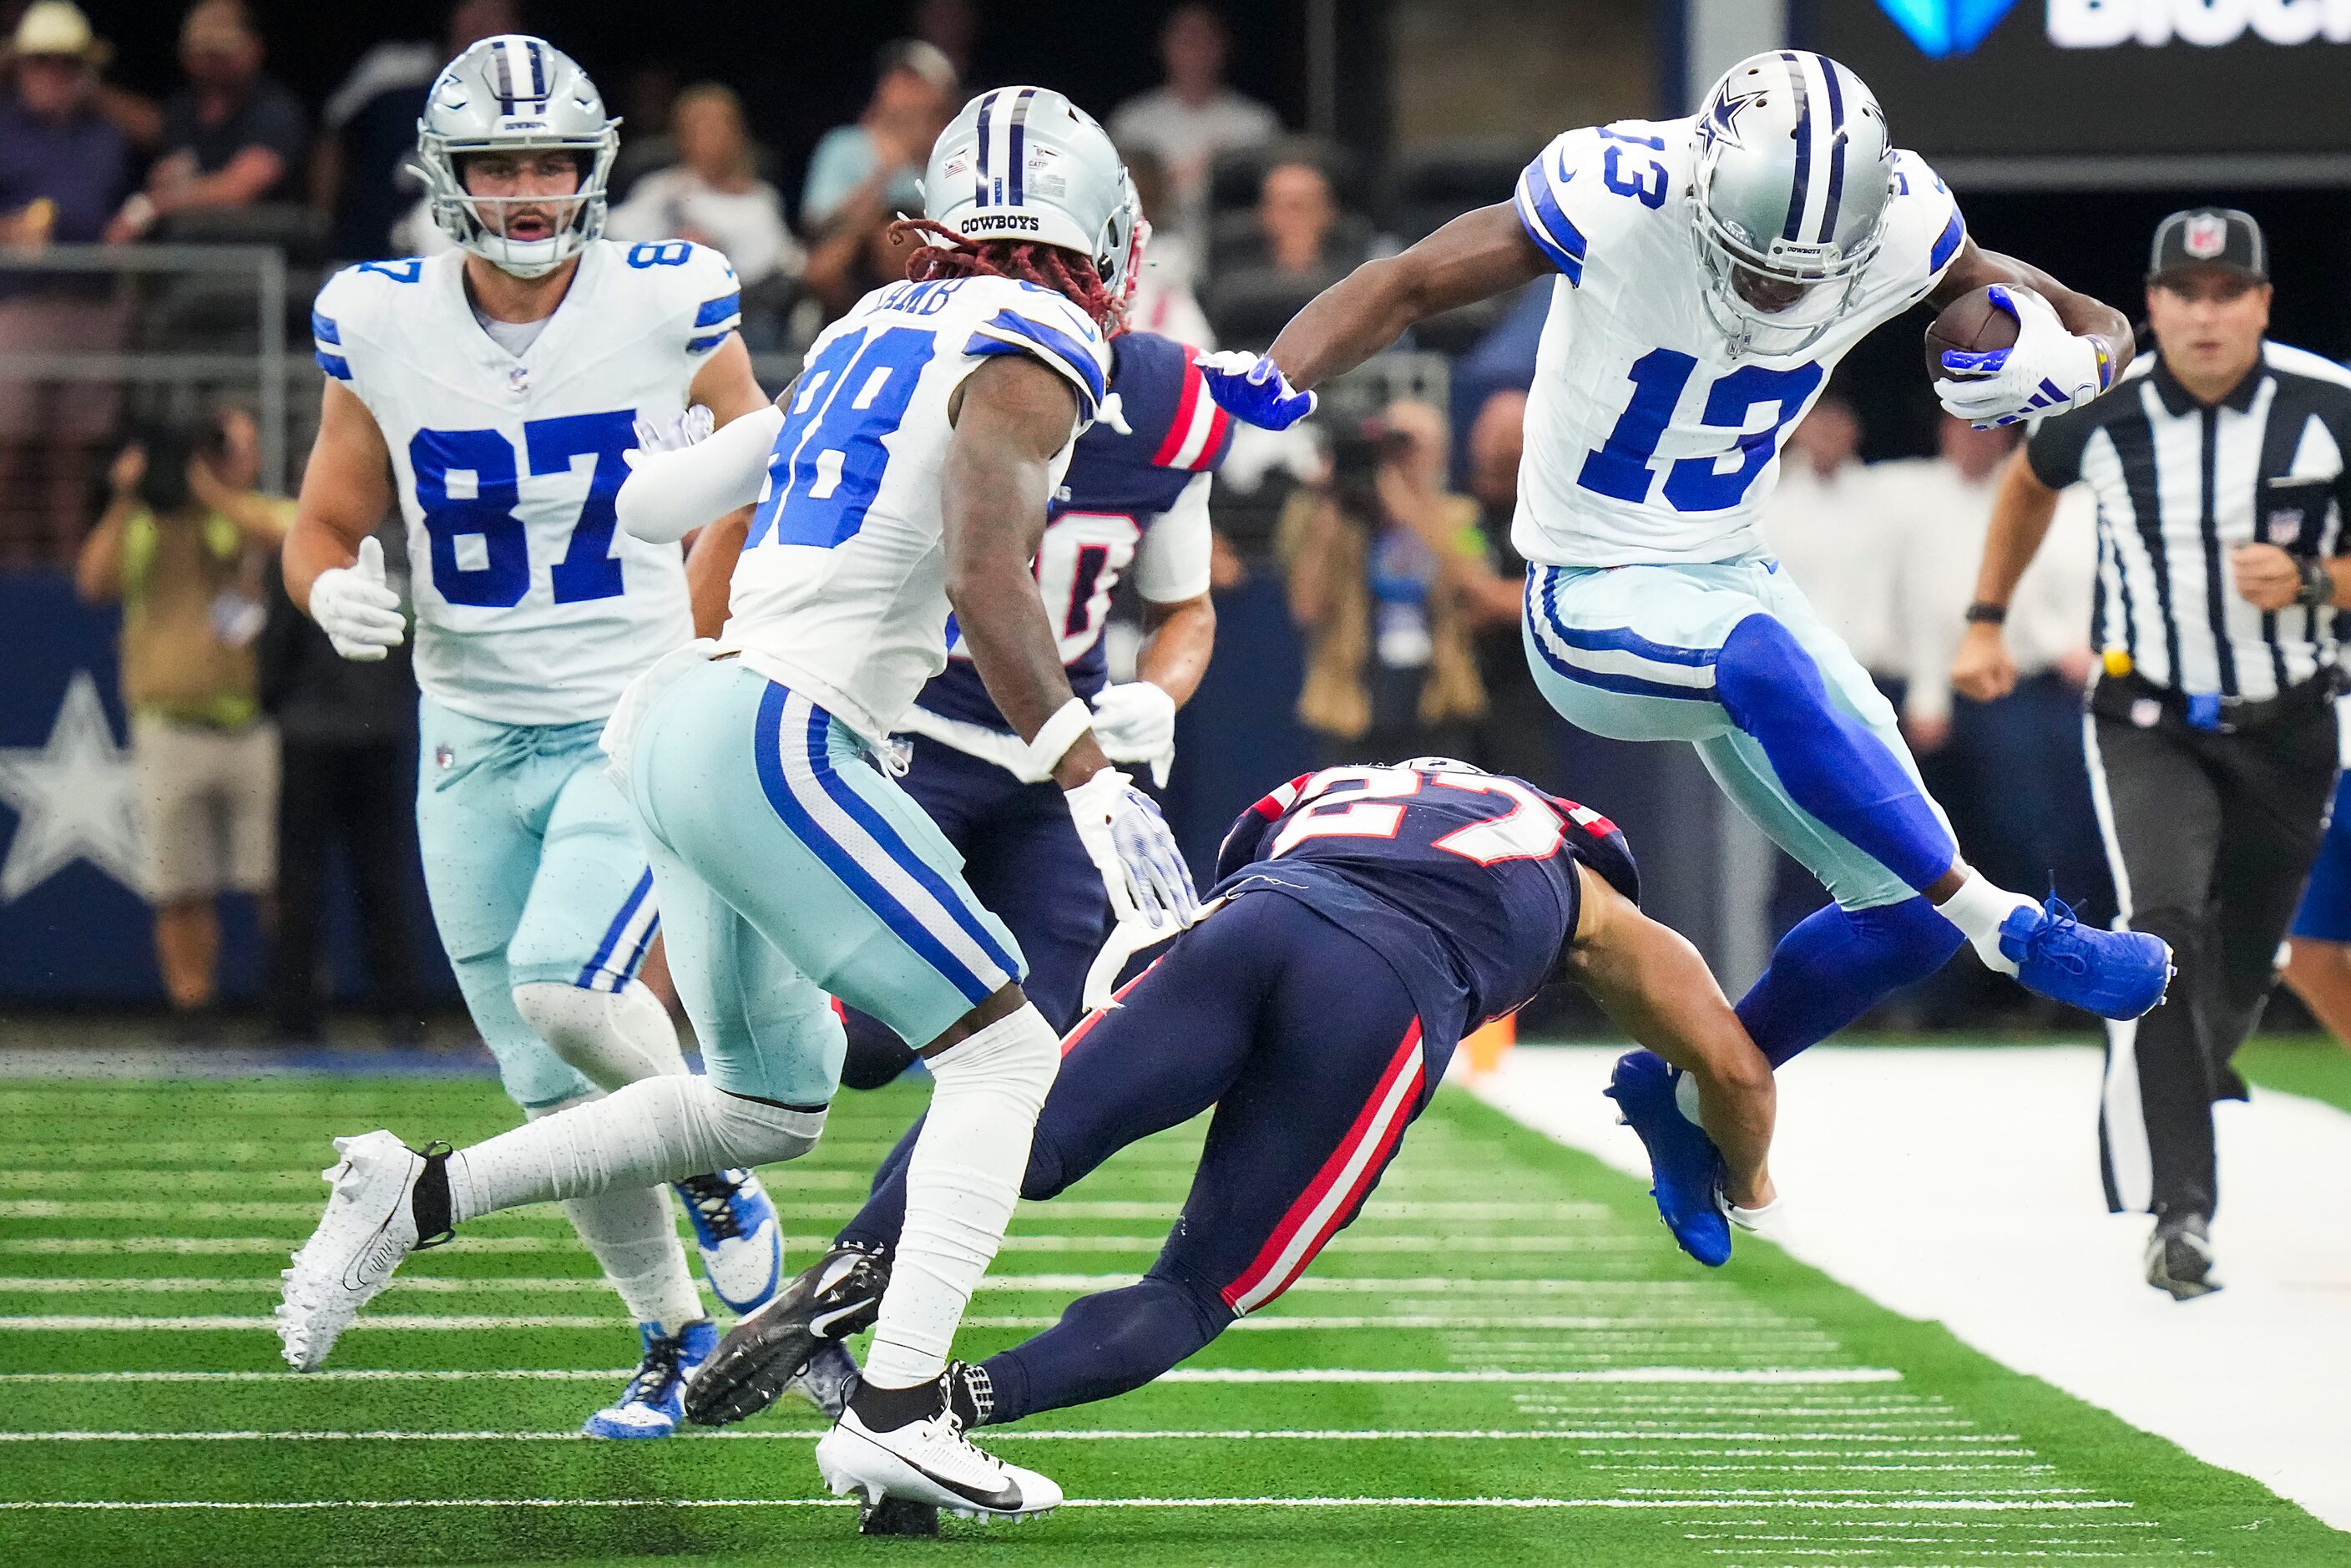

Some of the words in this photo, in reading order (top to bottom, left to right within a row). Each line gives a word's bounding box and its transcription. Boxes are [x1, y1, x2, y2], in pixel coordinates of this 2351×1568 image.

[961, 215, 1039, 234] COWBOYS
[1595, 126, 1669, 210] 13
[354, 255, 424, 283] 7
[741, 326, 938, 555] 88
[1576, 347, 1823, 513] 13
[408, 408, 640, 609] 87
[1032, 510, 1144, 666] 0
[1270, 767, 1571, 867] 27
